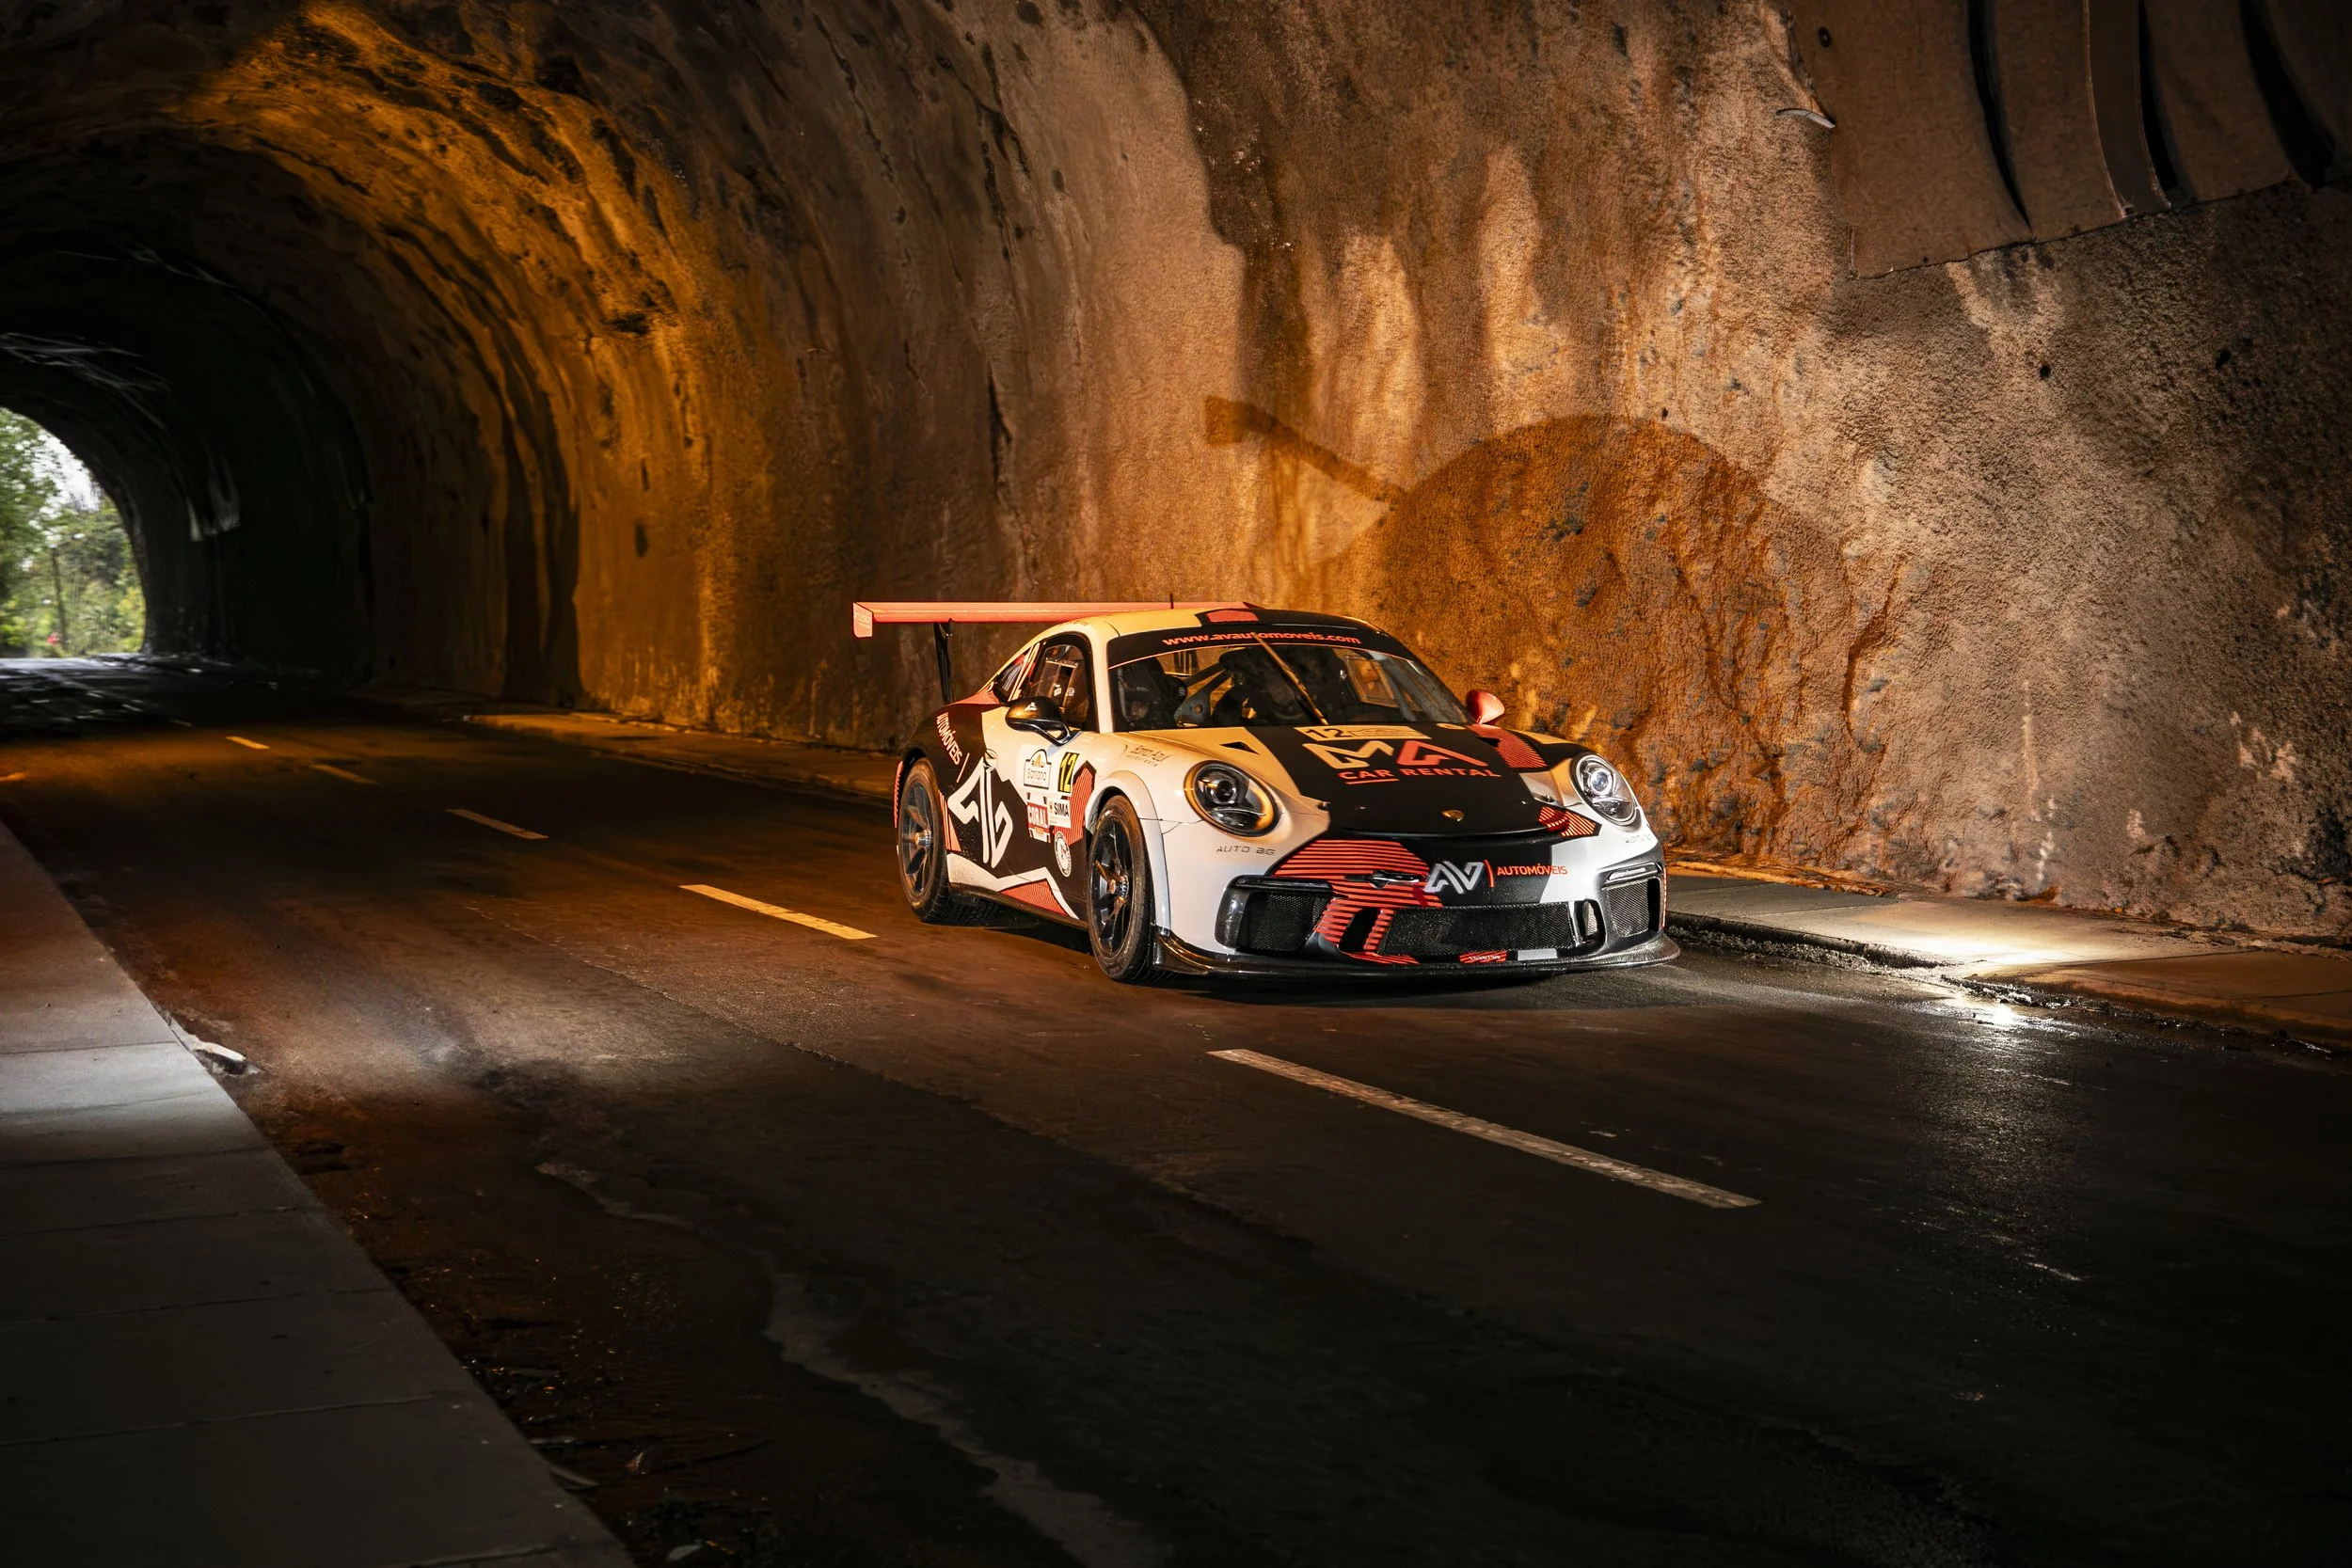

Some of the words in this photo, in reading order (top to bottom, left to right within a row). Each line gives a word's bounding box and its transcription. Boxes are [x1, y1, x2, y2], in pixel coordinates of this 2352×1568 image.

[1162, 631, 1362, 645] www.avauomoveis.com
[936, 711, 963, 766] AUTOMÓVEIS
[1306, 727, 1353, 738] 12
[1059, 752, 1078, 793] 12
[1337, 768, 1395, 780] CAR
[1399, 768, 1502, 778] RENTAL
[1054, 802, 1070, 817] SIMA
[1216, 845, 1251, 853] AUTO
[1497, 863, 1568, 877] AUTOMÓVEIS
